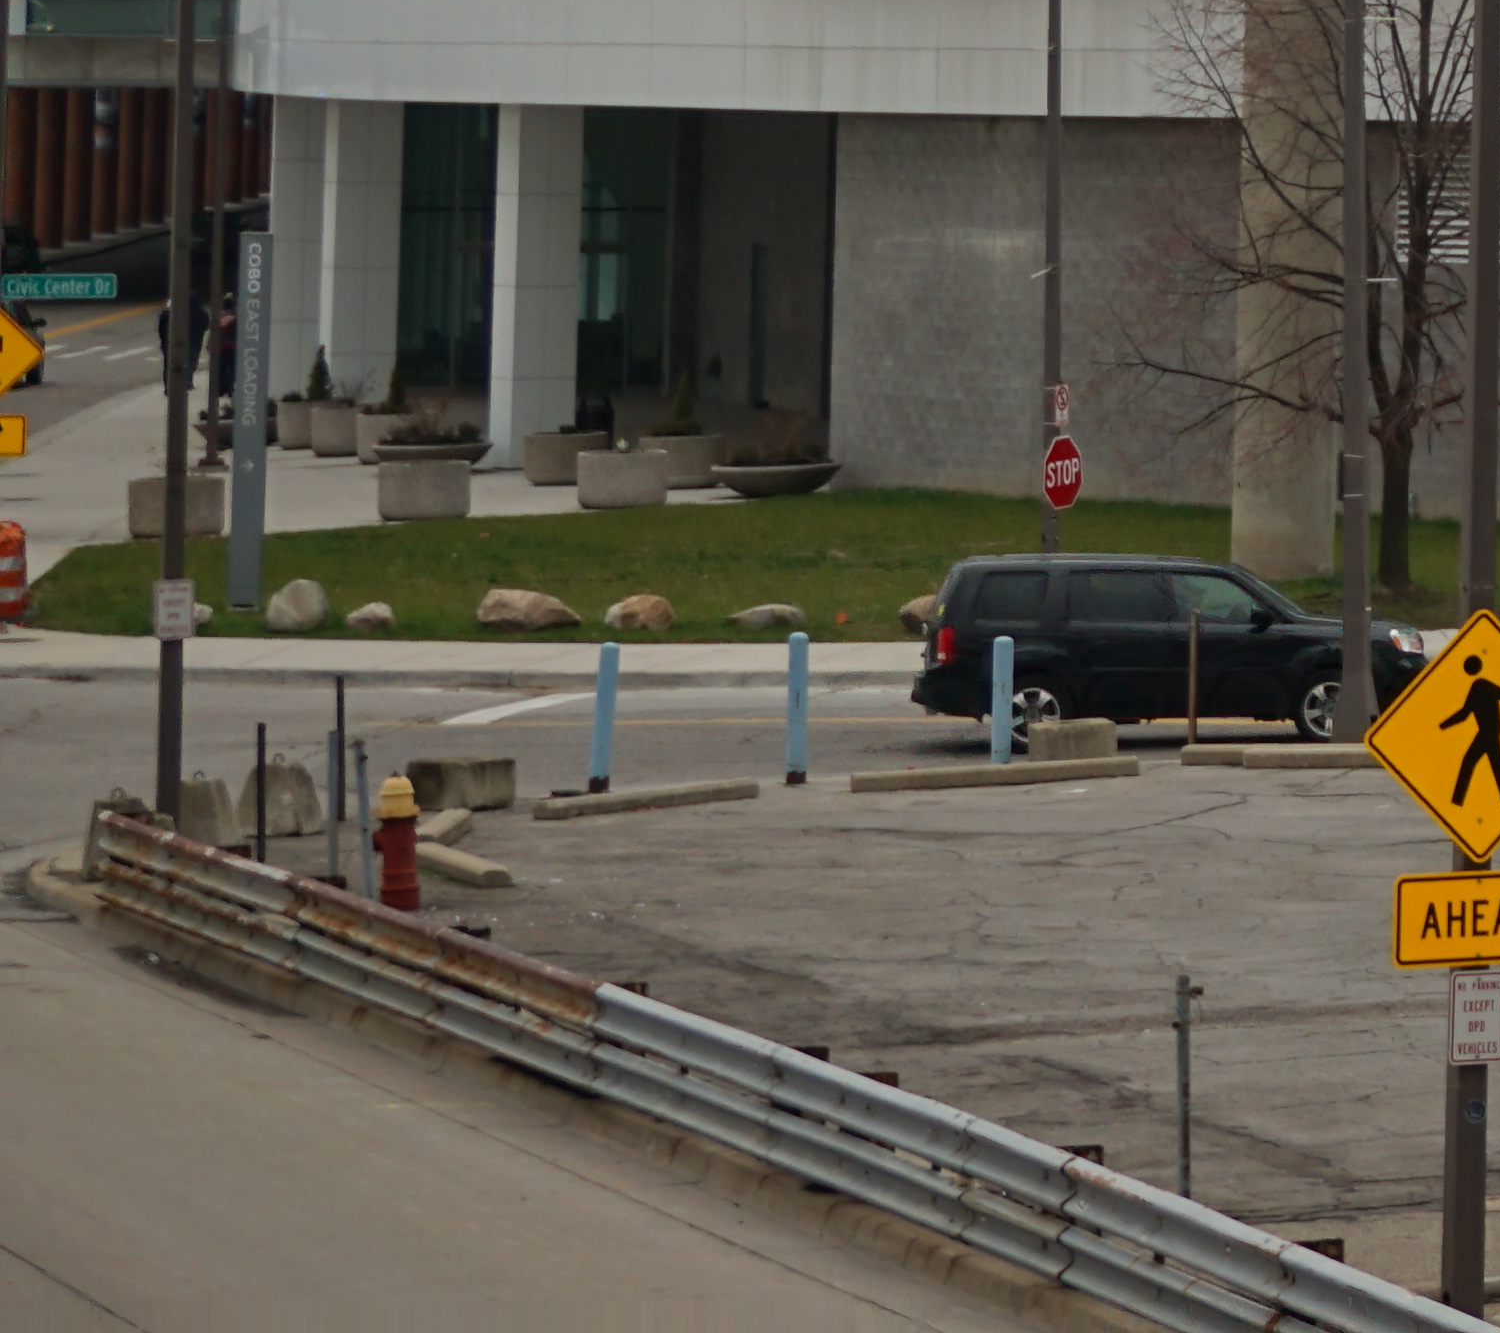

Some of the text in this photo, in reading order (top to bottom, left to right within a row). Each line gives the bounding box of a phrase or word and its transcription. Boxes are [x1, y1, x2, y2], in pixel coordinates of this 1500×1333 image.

[7, 278, 111, 294] Civic Center Dr
[242, 242, 261, 425] COBO EAST LOADING
[1046, 457, 1079, 488] STOP
[1457, 981, 1500, 991] NO PARKING
[1463, 999, 1495, 1012] EXCEPT
[1468, 1020, 1486, 1032] DPD
[1457, 1041, 1498, 1055] VEHICLES
